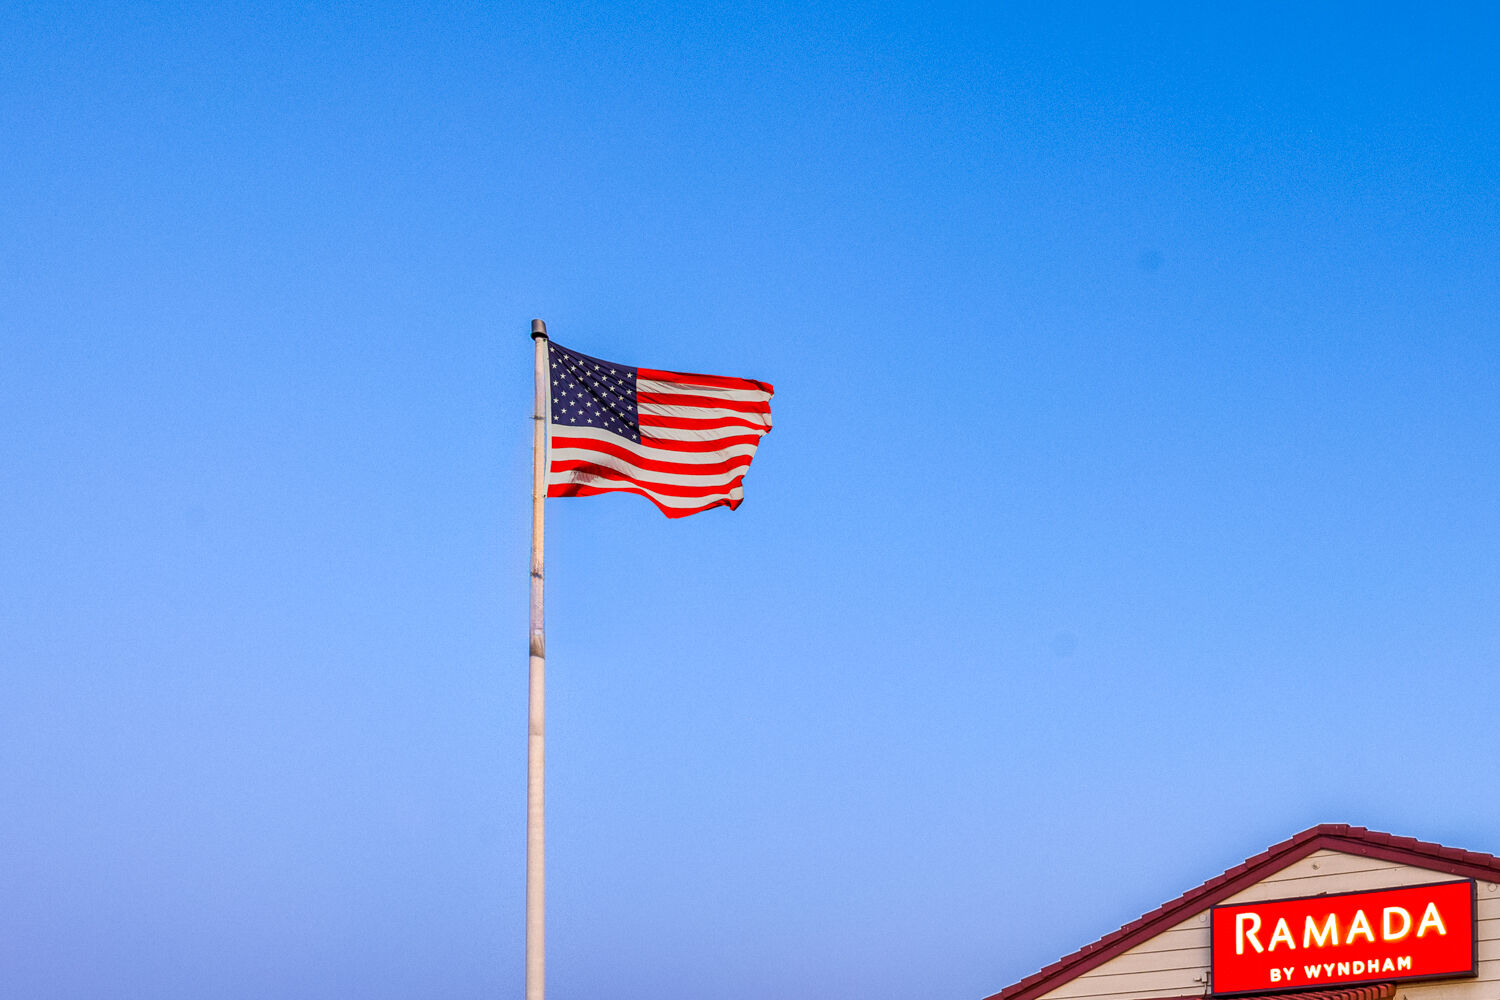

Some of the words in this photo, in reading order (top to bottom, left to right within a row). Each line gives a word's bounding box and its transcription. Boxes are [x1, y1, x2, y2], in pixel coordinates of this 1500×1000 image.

[1235, 902, 1447, 955] RAMADA
[1270, 966, 1295, 983] BY
[1304, 955, 1412, 979] WYNDHAM
